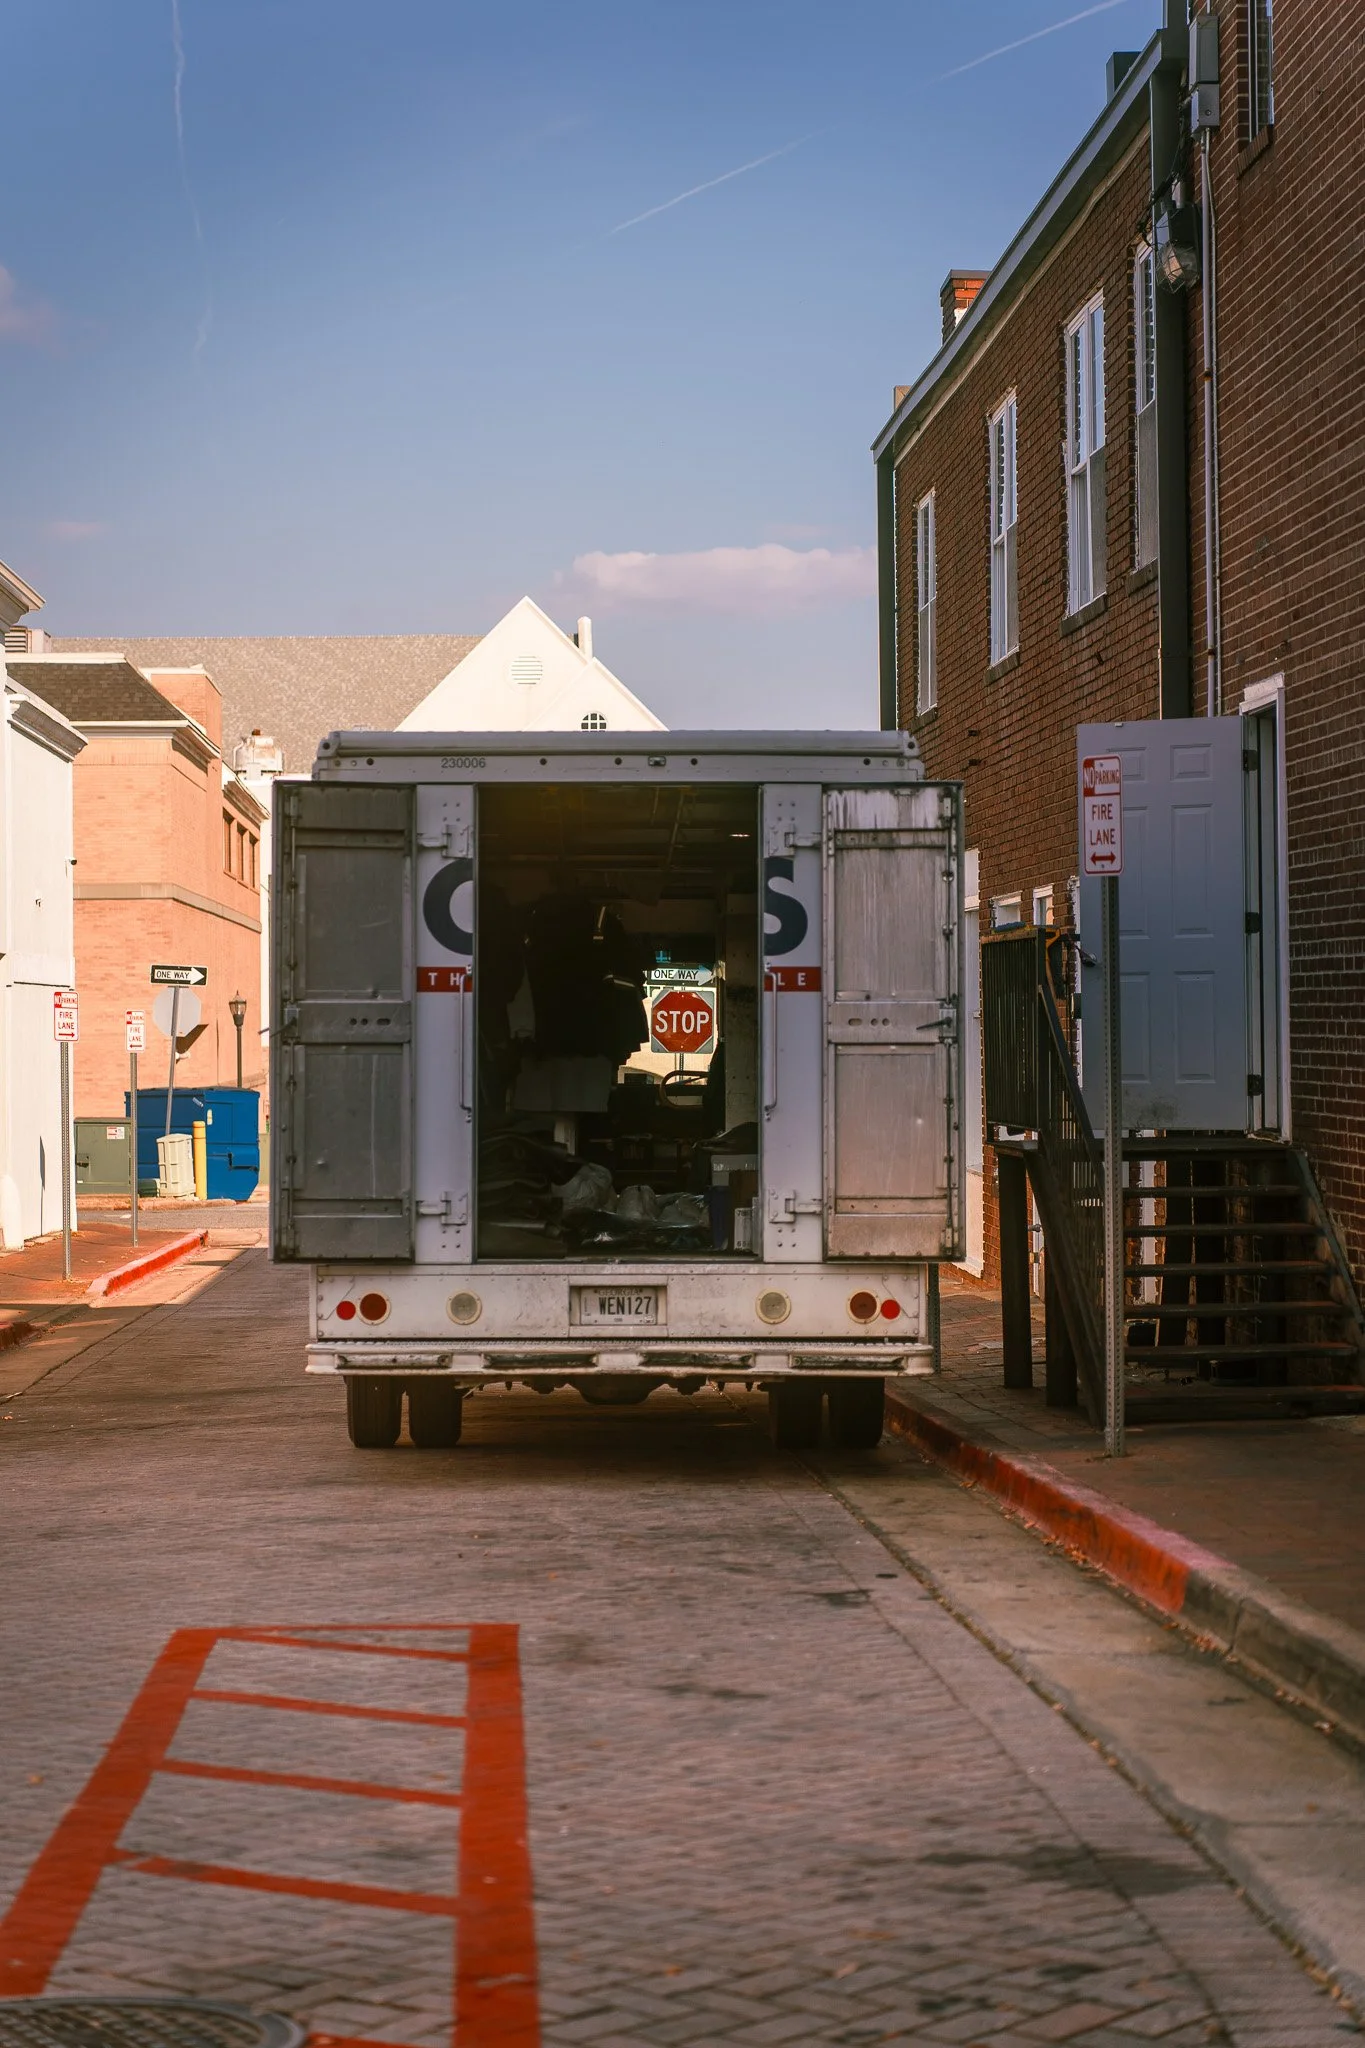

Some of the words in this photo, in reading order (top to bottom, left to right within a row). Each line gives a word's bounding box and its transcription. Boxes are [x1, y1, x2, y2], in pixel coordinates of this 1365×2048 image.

[441, 757, 486, 768] 230006
[1084, 767, 1094, 788] NO
[1095, 769, 1119, 785] PARKING
[1092, 804, 1113, 820] FIRE
[1090, 829, 1116, 845] LANE
[156, 970, 171, 979] ONE
[174, 971, 190, 979] WAY
[654, 969, 674, 979] ONE
[677, 970, 698, 980] WAY
[59, 1011, 73, 1019] FIRE
[58, 1022, 74, 1030] LANE
[655, 1010, 710, 1034] STOP
[599, 1296, 652, 1315] WEN127
